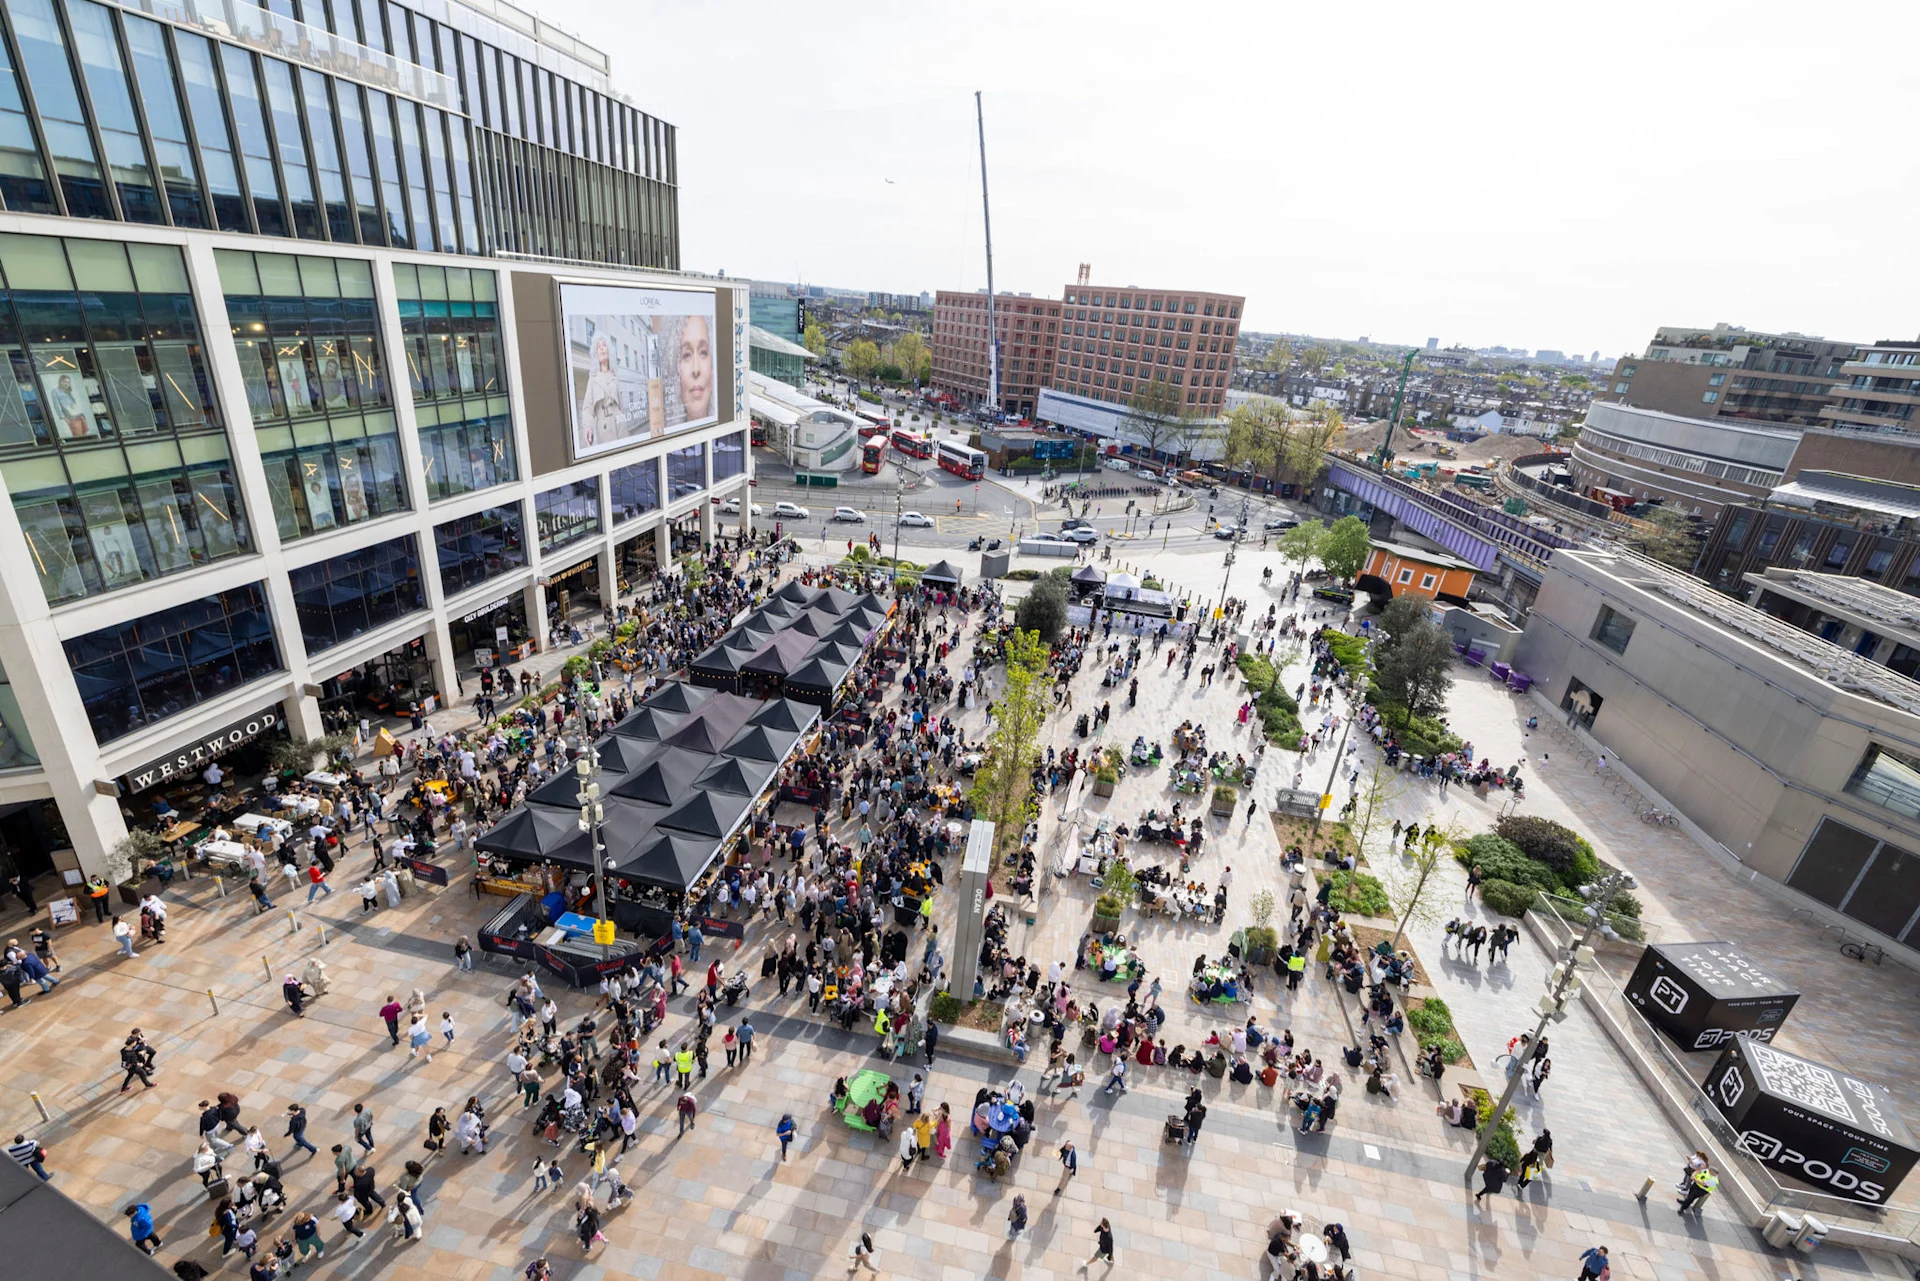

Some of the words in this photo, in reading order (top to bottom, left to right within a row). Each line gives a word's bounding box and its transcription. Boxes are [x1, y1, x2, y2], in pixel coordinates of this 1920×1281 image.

[464, 611, 477, 624] CITY
[134, 713, 276, 789] WESTWOOD
[164, 766, 193, 784] SPORTS
[195, 758, 210, 769] PUB
[212, 750, 227, 761] AND
[229, 735, 258, 752] KITCHEN
[973, 888, 983, 914] OCEAN
[1681, 957, 1720, 985] TIME
[1692, 953, 1735, 986] YOUR
[1706, 947, 1763, 989] SPACE
[1728, 952, 1771, 984] YOUR
[1657, 982, 1683, 1005] PT
[1783, 1106, 1805, 1119] YOUR
[1807, 1117, 1834, 1130] SPACE
[1843, 1130, 1866, 1143] YOUR
[1868, 1140, 1889, 1151] TIME
[1856, 1094, 1893, 1137] PODS
[1778, 1149, 1886, 1201] PODS
